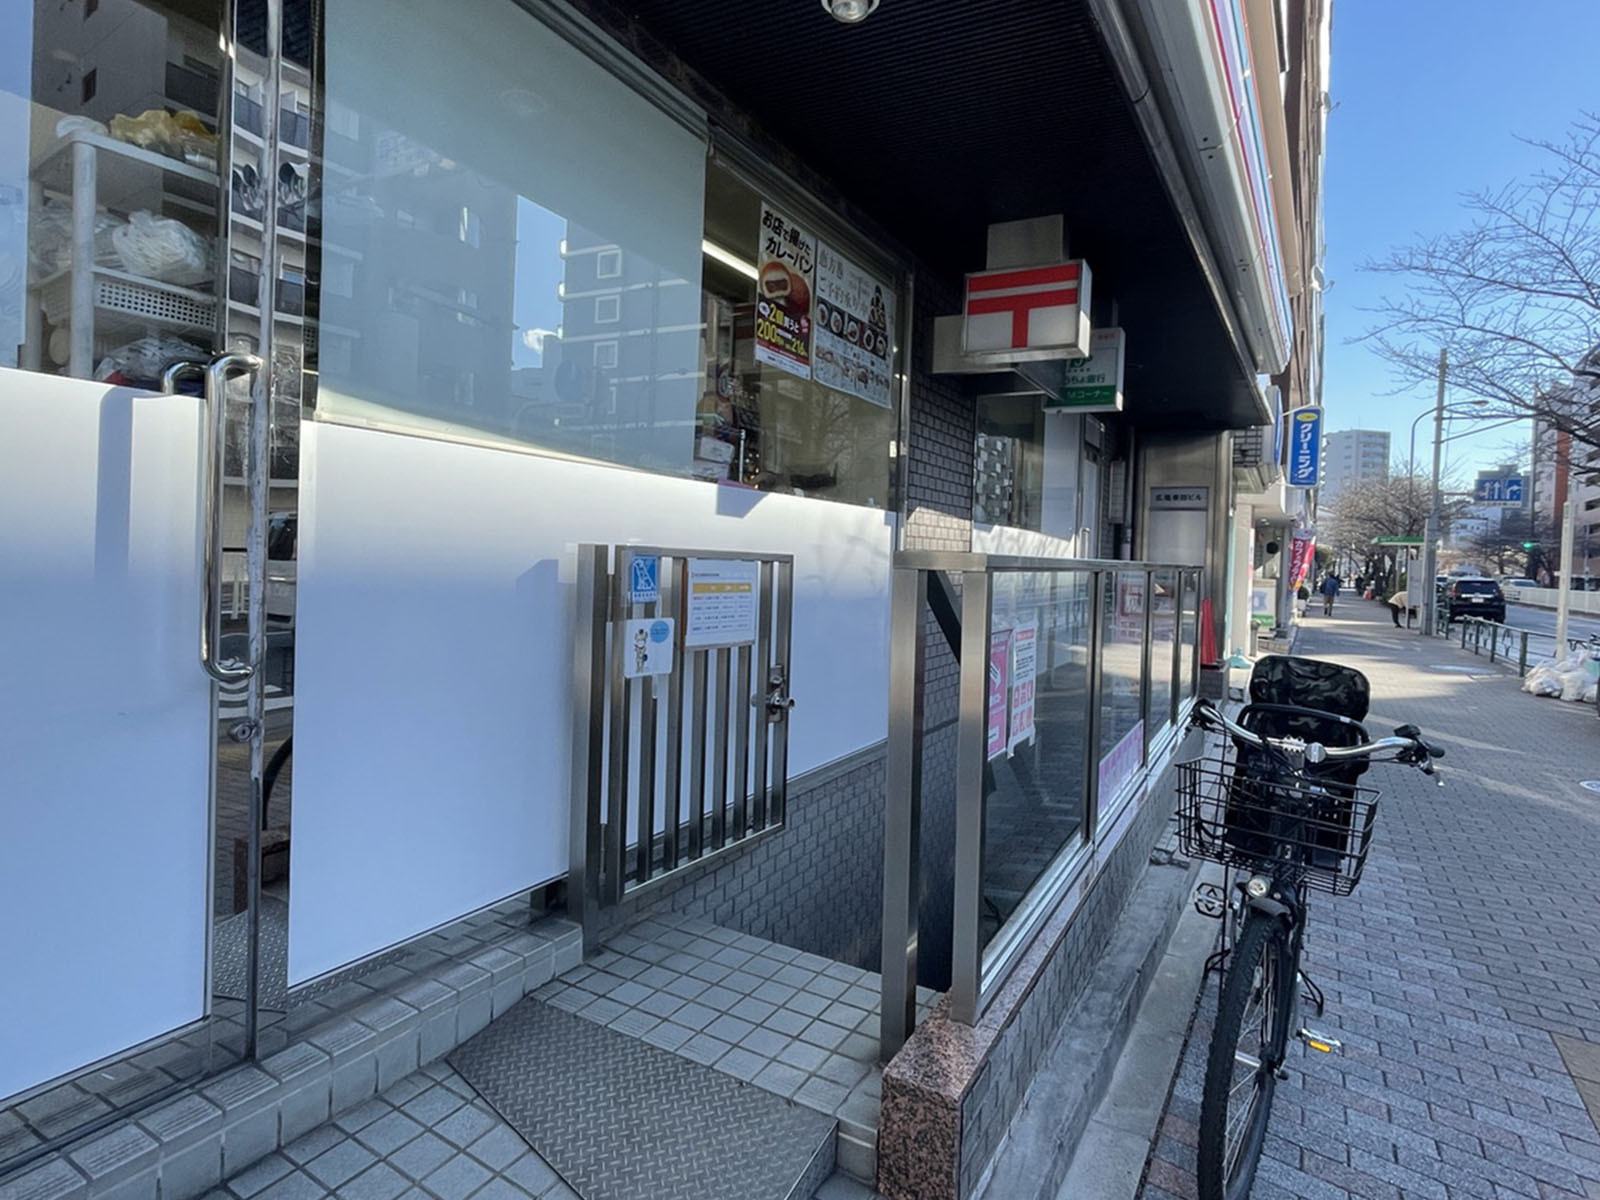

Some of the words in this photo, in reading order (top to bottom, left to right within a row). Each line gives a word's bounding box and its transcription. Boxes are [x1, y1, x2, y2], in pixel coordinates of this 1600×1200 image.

[765, 237, 813, 274] カレーパン
[1297, 423, 1314, 479] クリーニング
